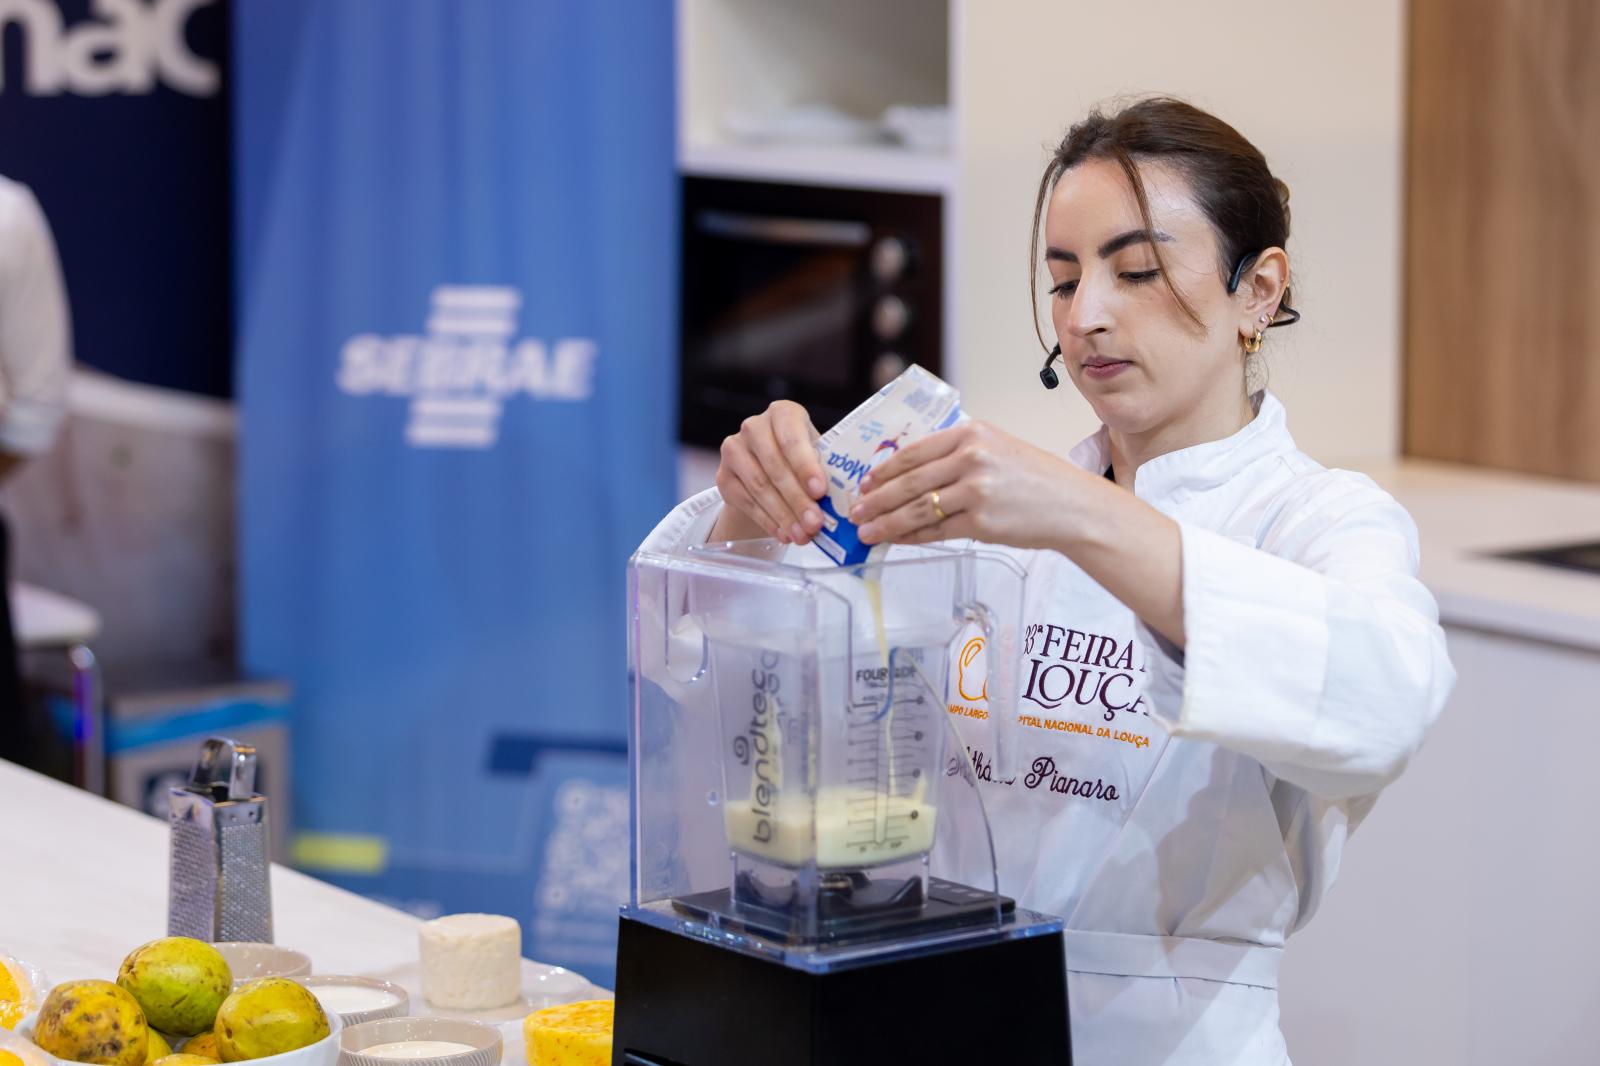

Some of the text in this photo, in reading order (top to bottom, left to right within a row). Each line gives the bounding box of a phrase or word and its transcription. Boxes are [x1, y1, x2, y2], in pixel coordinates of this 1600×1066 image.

[338, 335, 596, 399] SEBRAE
[828, 453, 870, 484] Moça
[1038, 624, 1134, 671] FEIRA
[948, 704, 964, 715] MPO
[964, 707, 987, 719] LARGO
[1044, 719, 1093, 735] NACIONAL
[1096, 727, 1111, 738] DA
[1113, 731, 1150, 748] LOUÇA
[750, 669, 772, 843] blendtec
[1024, 756, 1119, 801] Pianaro
